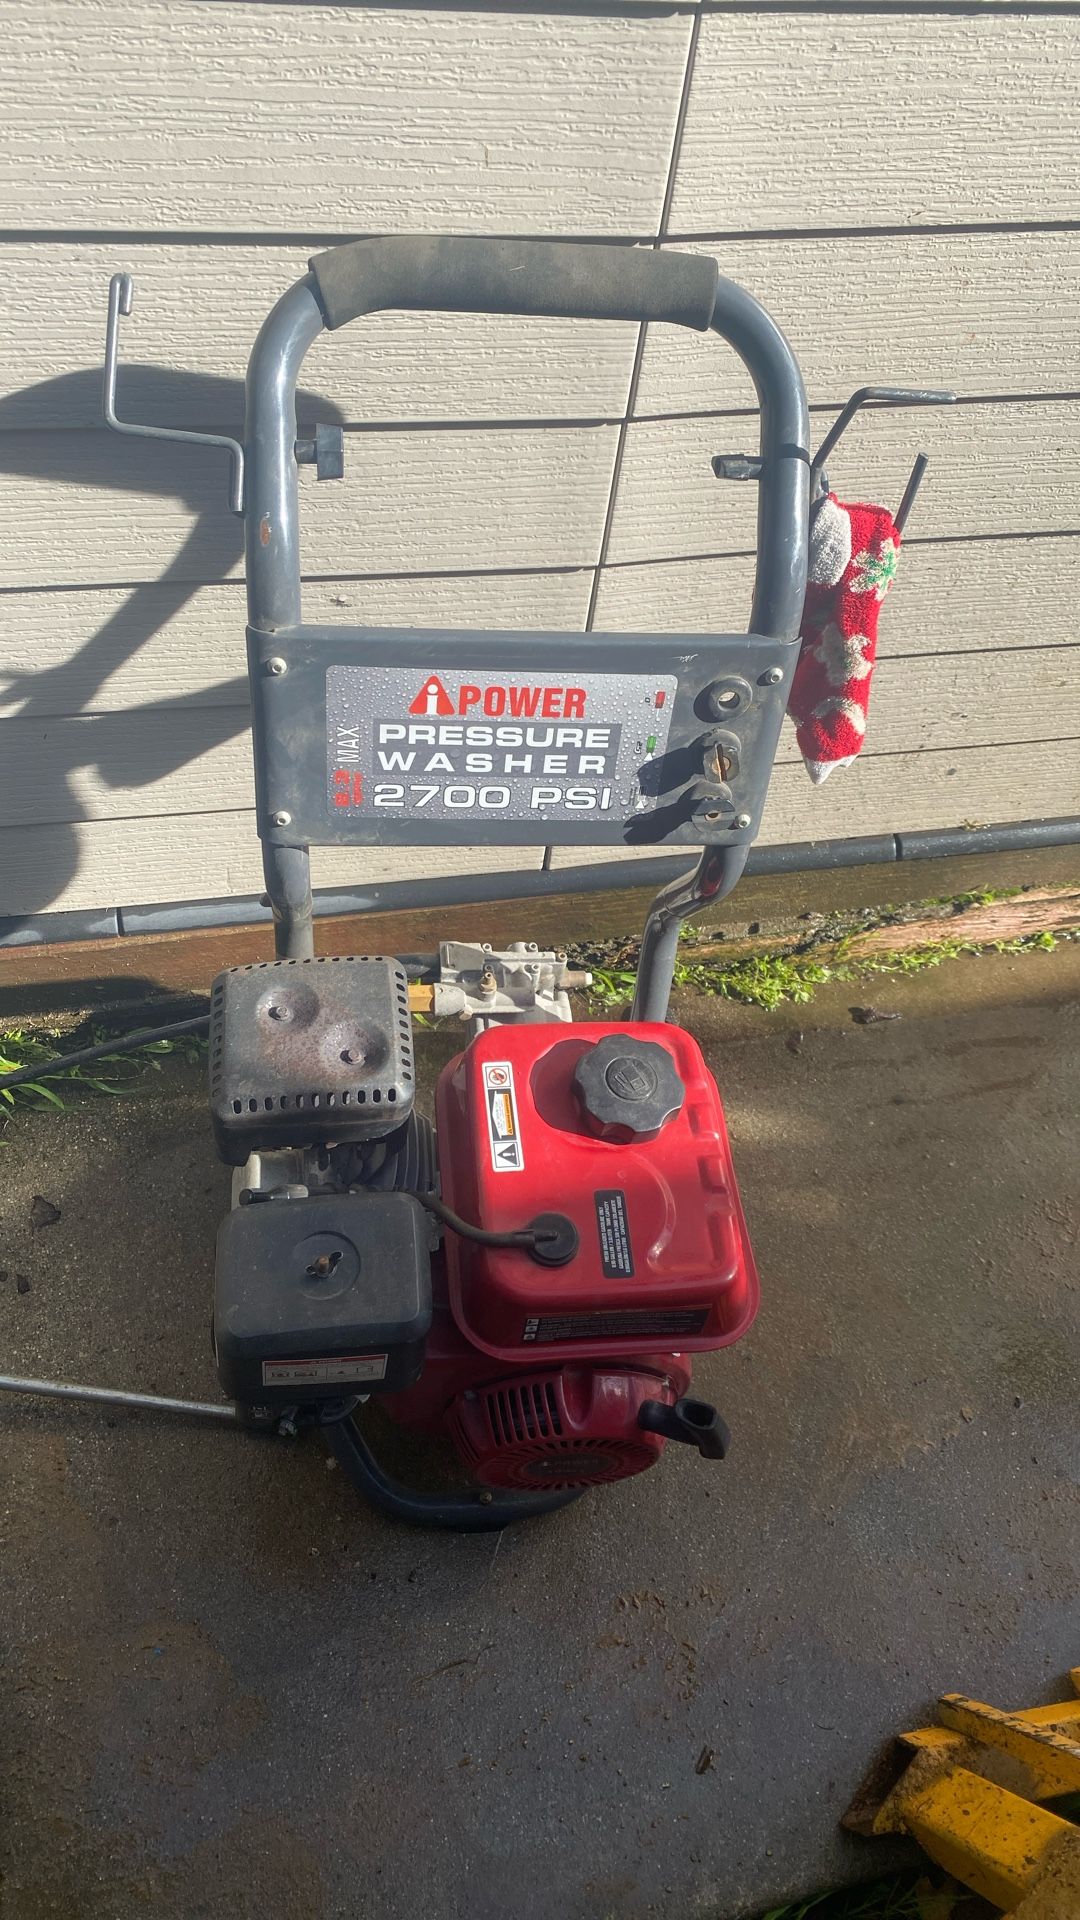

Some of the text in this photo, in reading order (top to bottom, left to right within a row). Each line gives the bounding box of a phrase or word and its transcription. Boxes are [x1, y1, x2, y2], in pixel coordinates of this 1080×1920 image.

[336, 726, 360, 763] MAX
[379, 723, 611, 748] PRESSURE
[377, 751, 606, 775] WASHER
[373, 784, 511, 809] 2700
[530, 785, 613, 810] PSI
